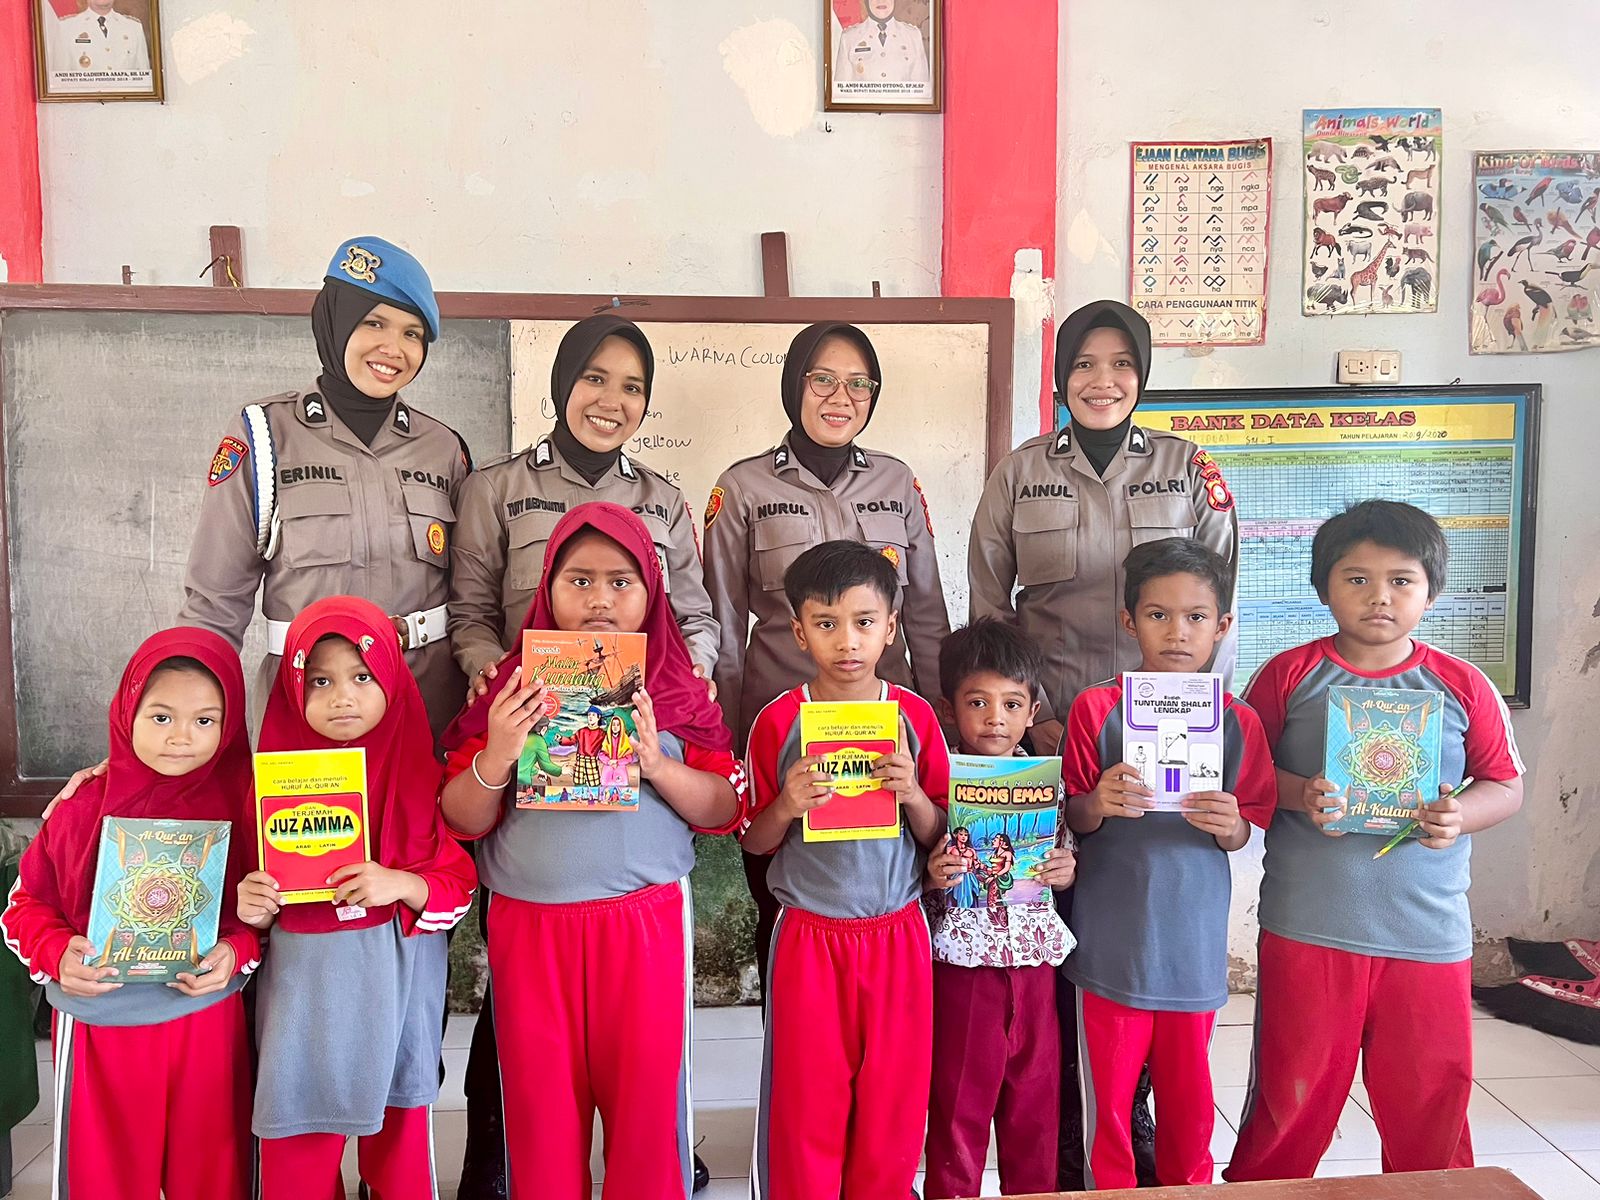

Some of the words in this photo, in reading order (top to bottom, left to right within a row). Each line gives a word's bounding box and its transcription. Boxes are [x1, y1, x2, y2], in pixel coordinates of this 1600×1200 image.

[1315, 114, 1378, 130] Animals
[1174, 147, 1225, 161] LONTARA
[1227, 145, 1266, 161] BUGIS
[1479, 155, 1514, 169] Kind
[1179, 246, 1186, 254] ja
[1137, 301, 1164, 309] CARA
[1166, 300, 1233, 308] PENGGUNAAN
[1235, 299, 1257, 308] TITIK
[669, 346, 736, 365] WARNA
[1171, 415, 1245, 431] BANK
[1251, 413, 1324, 430] DATA
[1330, 411, 1416, 427] KELAS
[280, 466, 342, 484] ERINIL
[400, 469, 449, 492] POLRI
[1019, 484, 1073, 499] AINUL
[1129, 479, 1185, 497] POLRI
[634, 505, 668, 522] OLRI
[757, 503, 809, 518] NURUL
[857, 500, 902, 514] POLRI
[287, 777, 308, 785] belajar
[955, 784, 1010, 804] KEONG
[1012, 784, 1055, 804] EMAS
[1350, 802, 1414, 818] Al-Kalam
[270, 818, 298, 833] JUZ
[302, 815, 354, 832] AMMA
[112, 945, 187, 963] Al-Kalam
